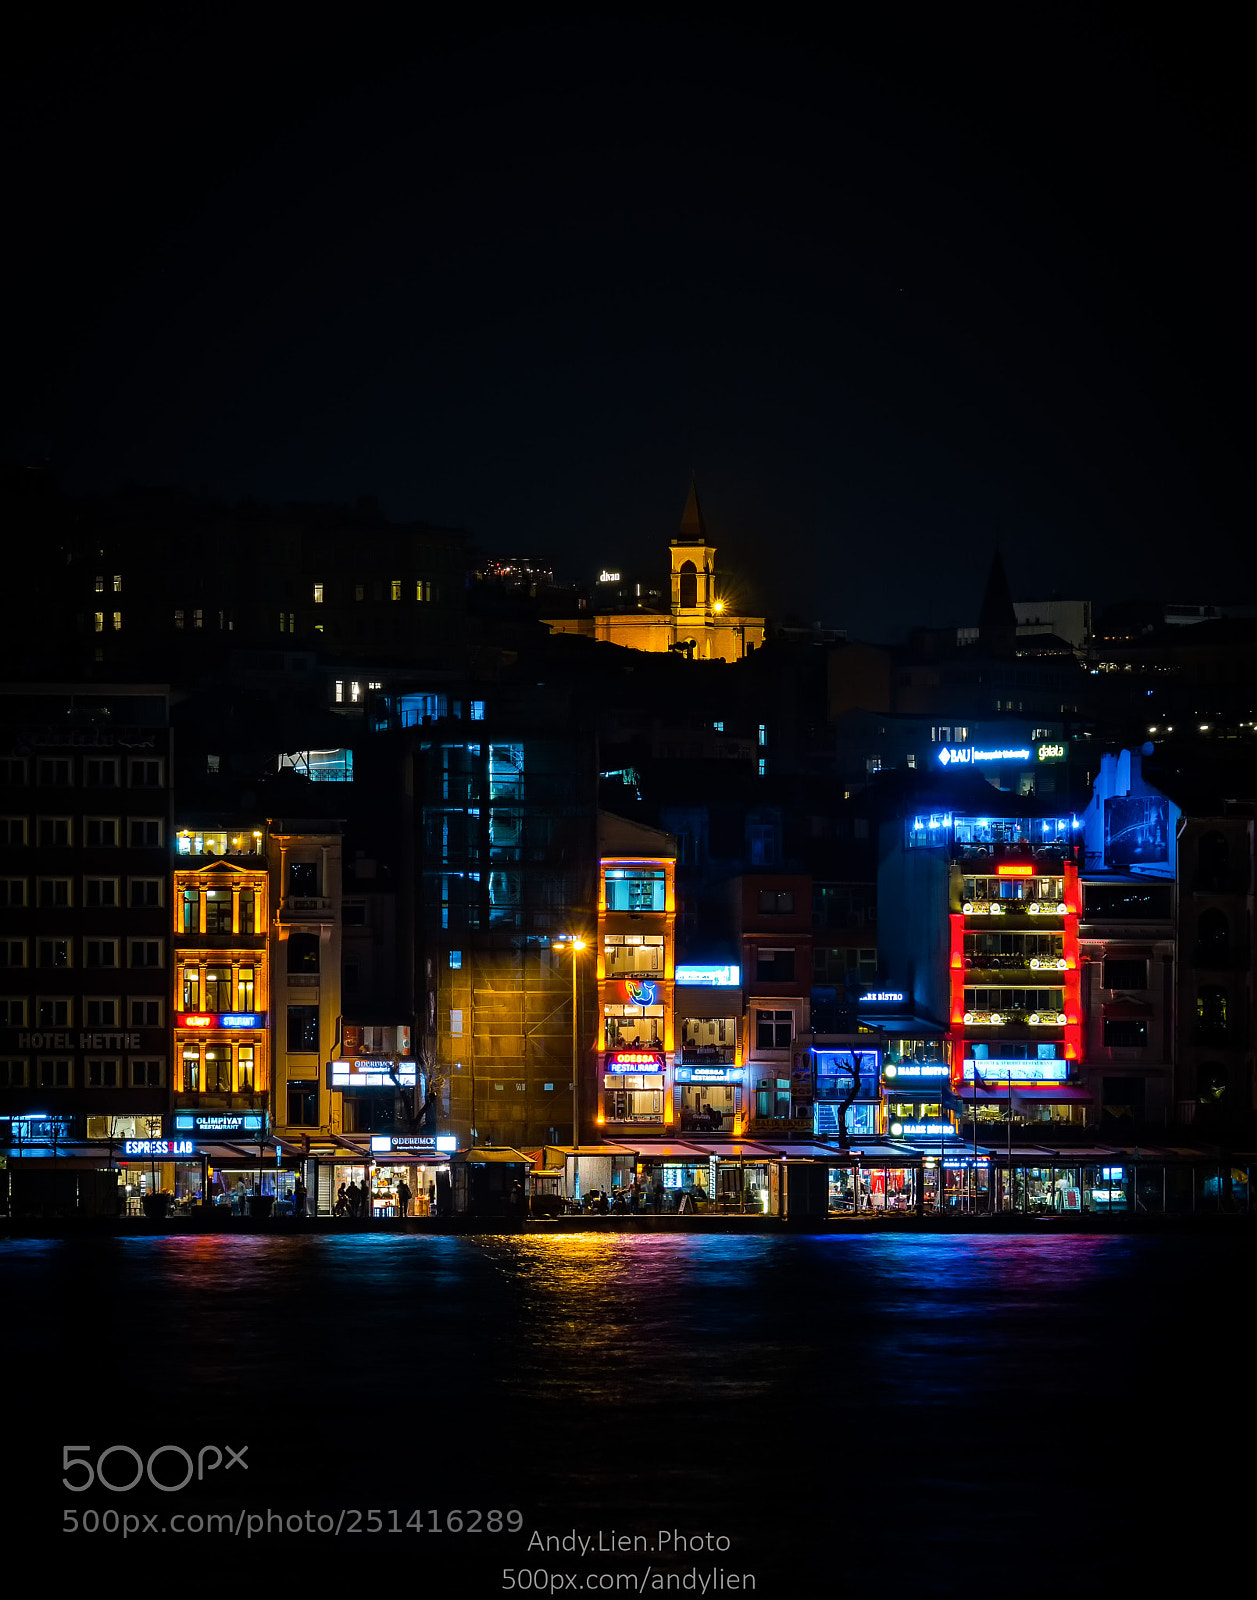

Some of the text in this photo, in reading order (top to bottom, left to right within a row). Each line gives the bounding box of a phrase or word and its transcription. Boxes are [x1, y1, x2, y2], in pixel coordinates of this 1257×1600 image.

[19, 1033, 140, 1049] HOTEL HETTIE
[617, 1054, 654, 1063] ODESSA
[611, 1063, 659, 1073] RESTAURANT
